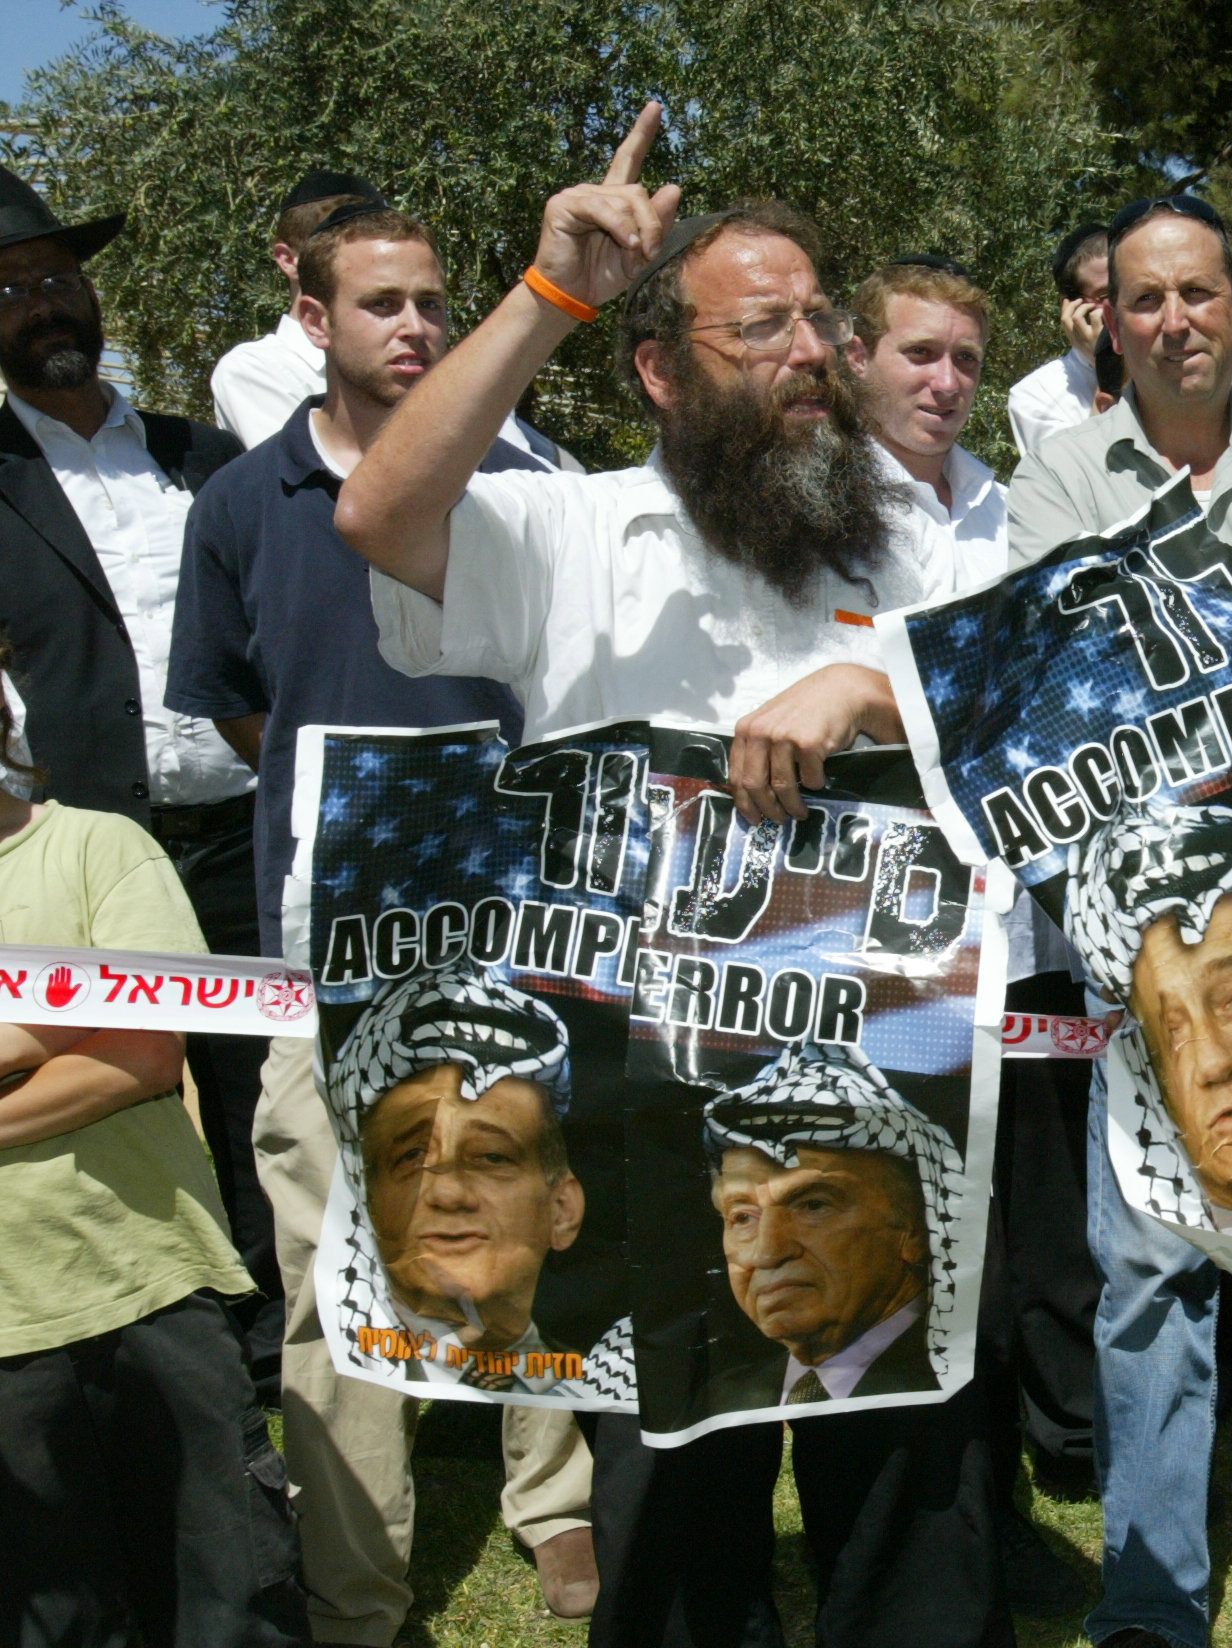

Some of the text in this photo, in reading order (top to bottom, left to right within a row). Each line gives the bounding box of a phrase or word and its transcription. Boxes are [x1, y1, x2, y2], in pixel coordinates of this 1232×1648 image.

[99, 964, 255, 1009] ישראל
[446, 1344, 519, 1377] יהודית
[525, 1352, 585, 1380] חזית
